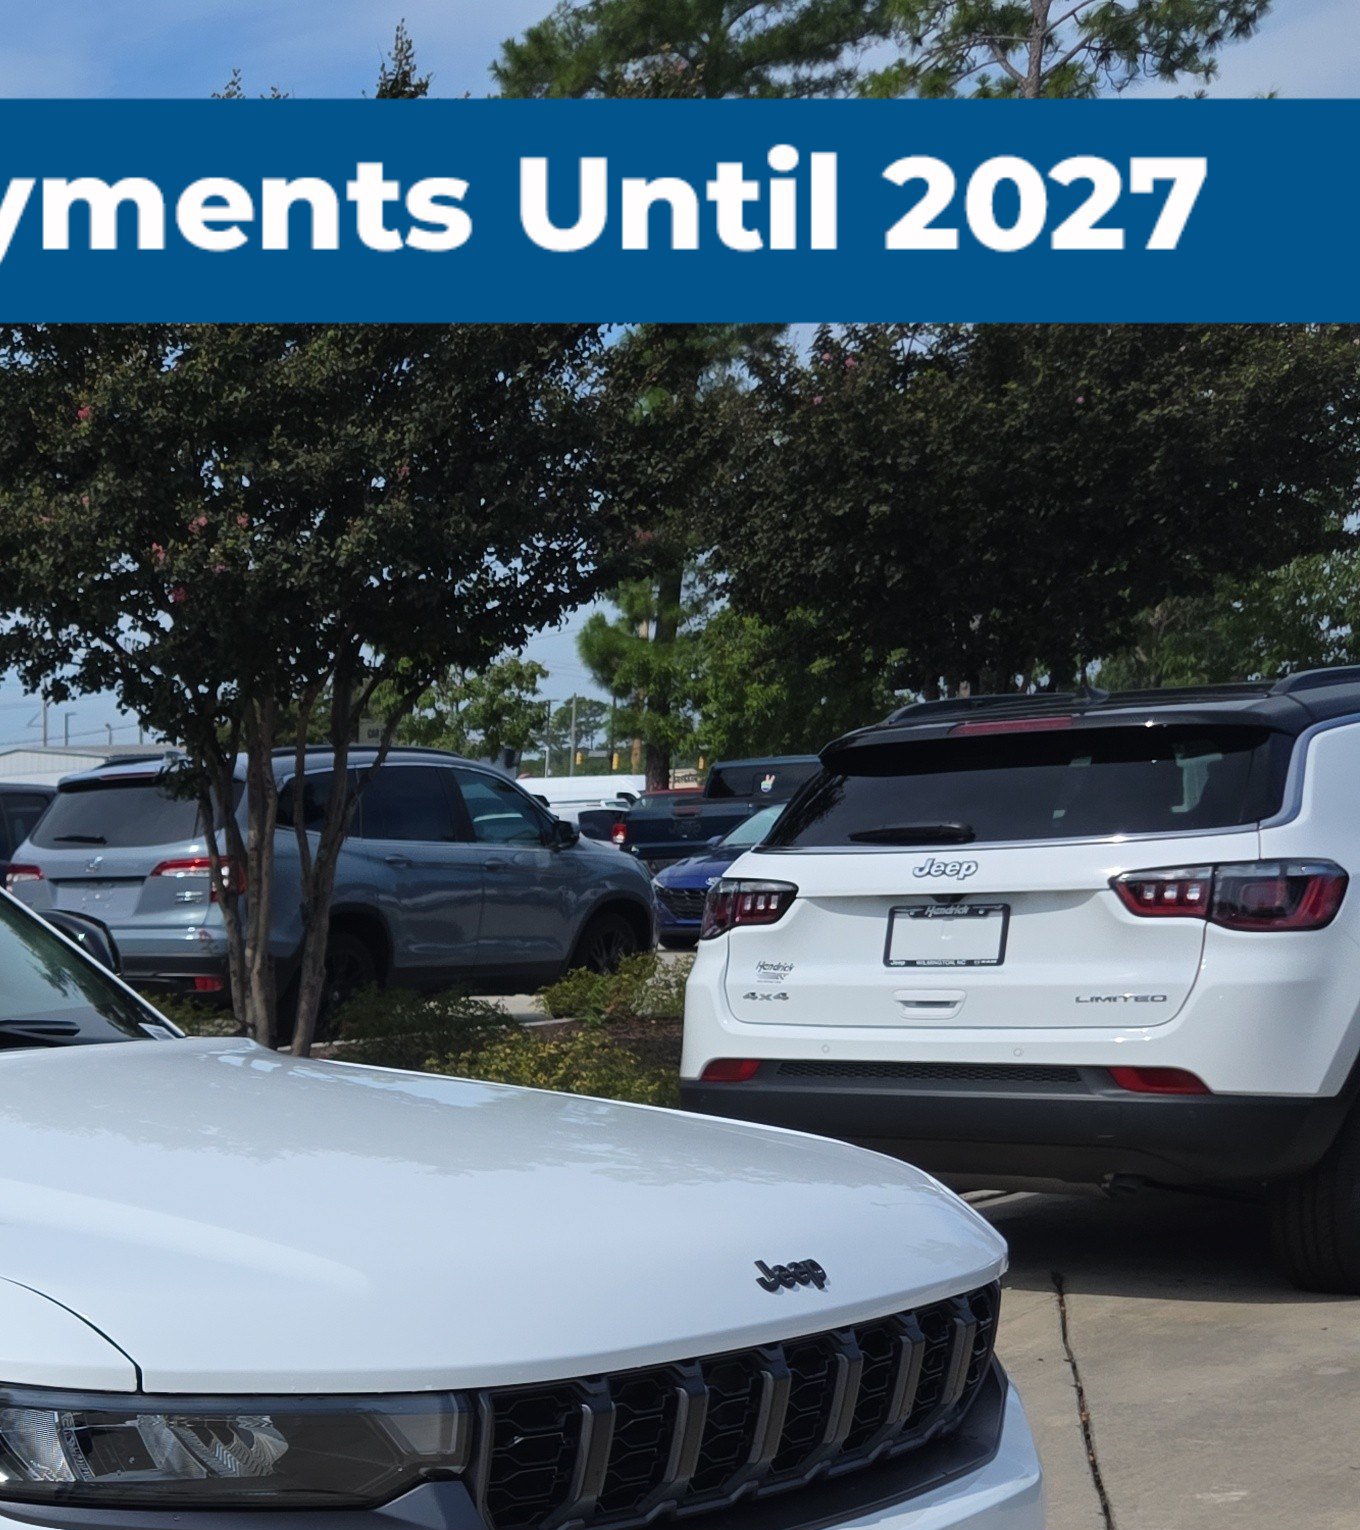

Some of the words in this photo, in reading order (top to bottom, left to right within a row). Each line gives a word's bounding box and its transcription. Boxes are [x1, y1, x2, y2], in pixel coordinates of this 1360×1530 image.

[912, 858, 978, 880] Jeep
[925, 905, 969, 917] Hendrick
[756, 961, 795, 973] Hendrick
[1075, 995, 1167, 1003] LIMITED
[754, 1259, 827, 1293] Jeep
